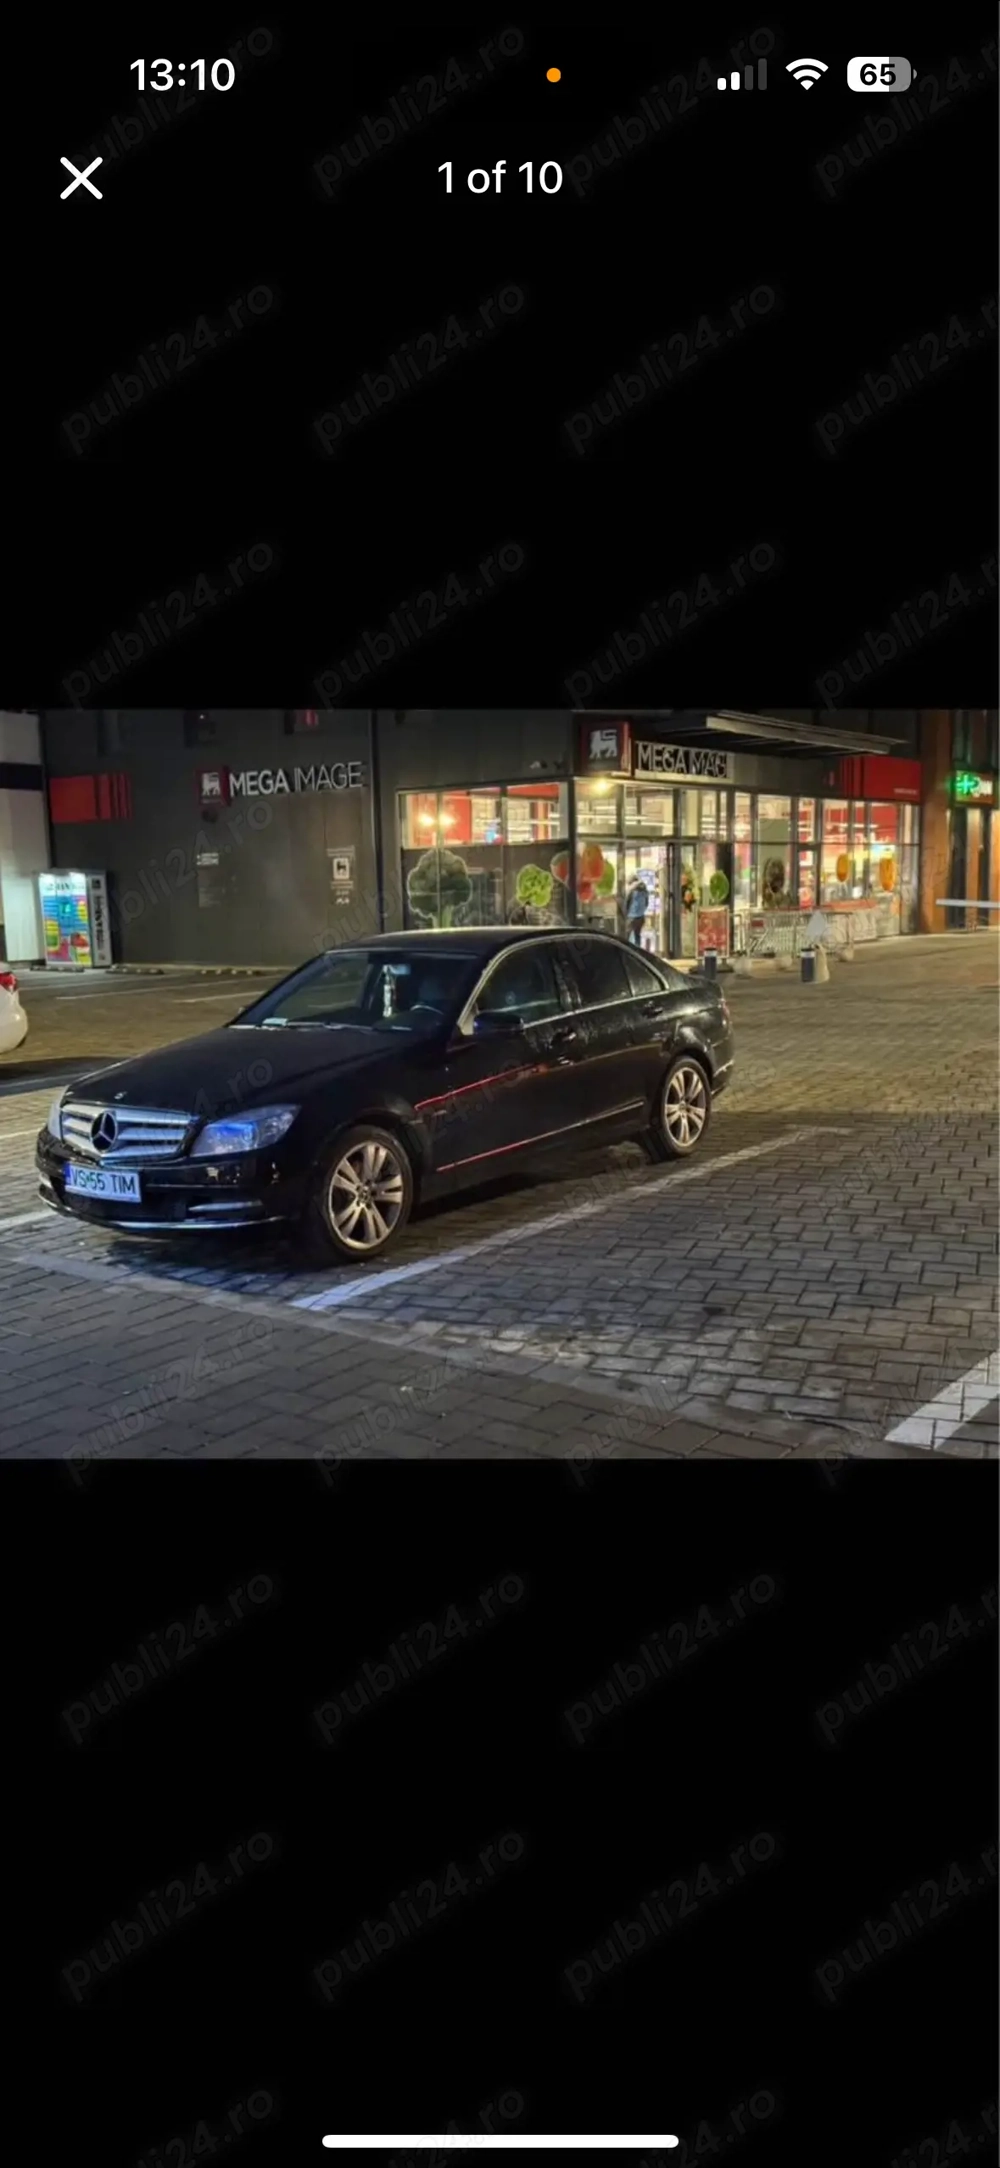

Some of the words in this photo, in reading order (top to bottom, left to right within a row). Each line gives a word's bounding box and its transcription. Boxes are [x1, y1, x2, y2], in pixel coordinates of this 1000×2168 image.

[637, 741, 688, 774] MEGA
[228, 767, 290, 798] MEGA
[293, 760, 363, 792] IMAGE
[109, 1173, 136, 1194] TIM
